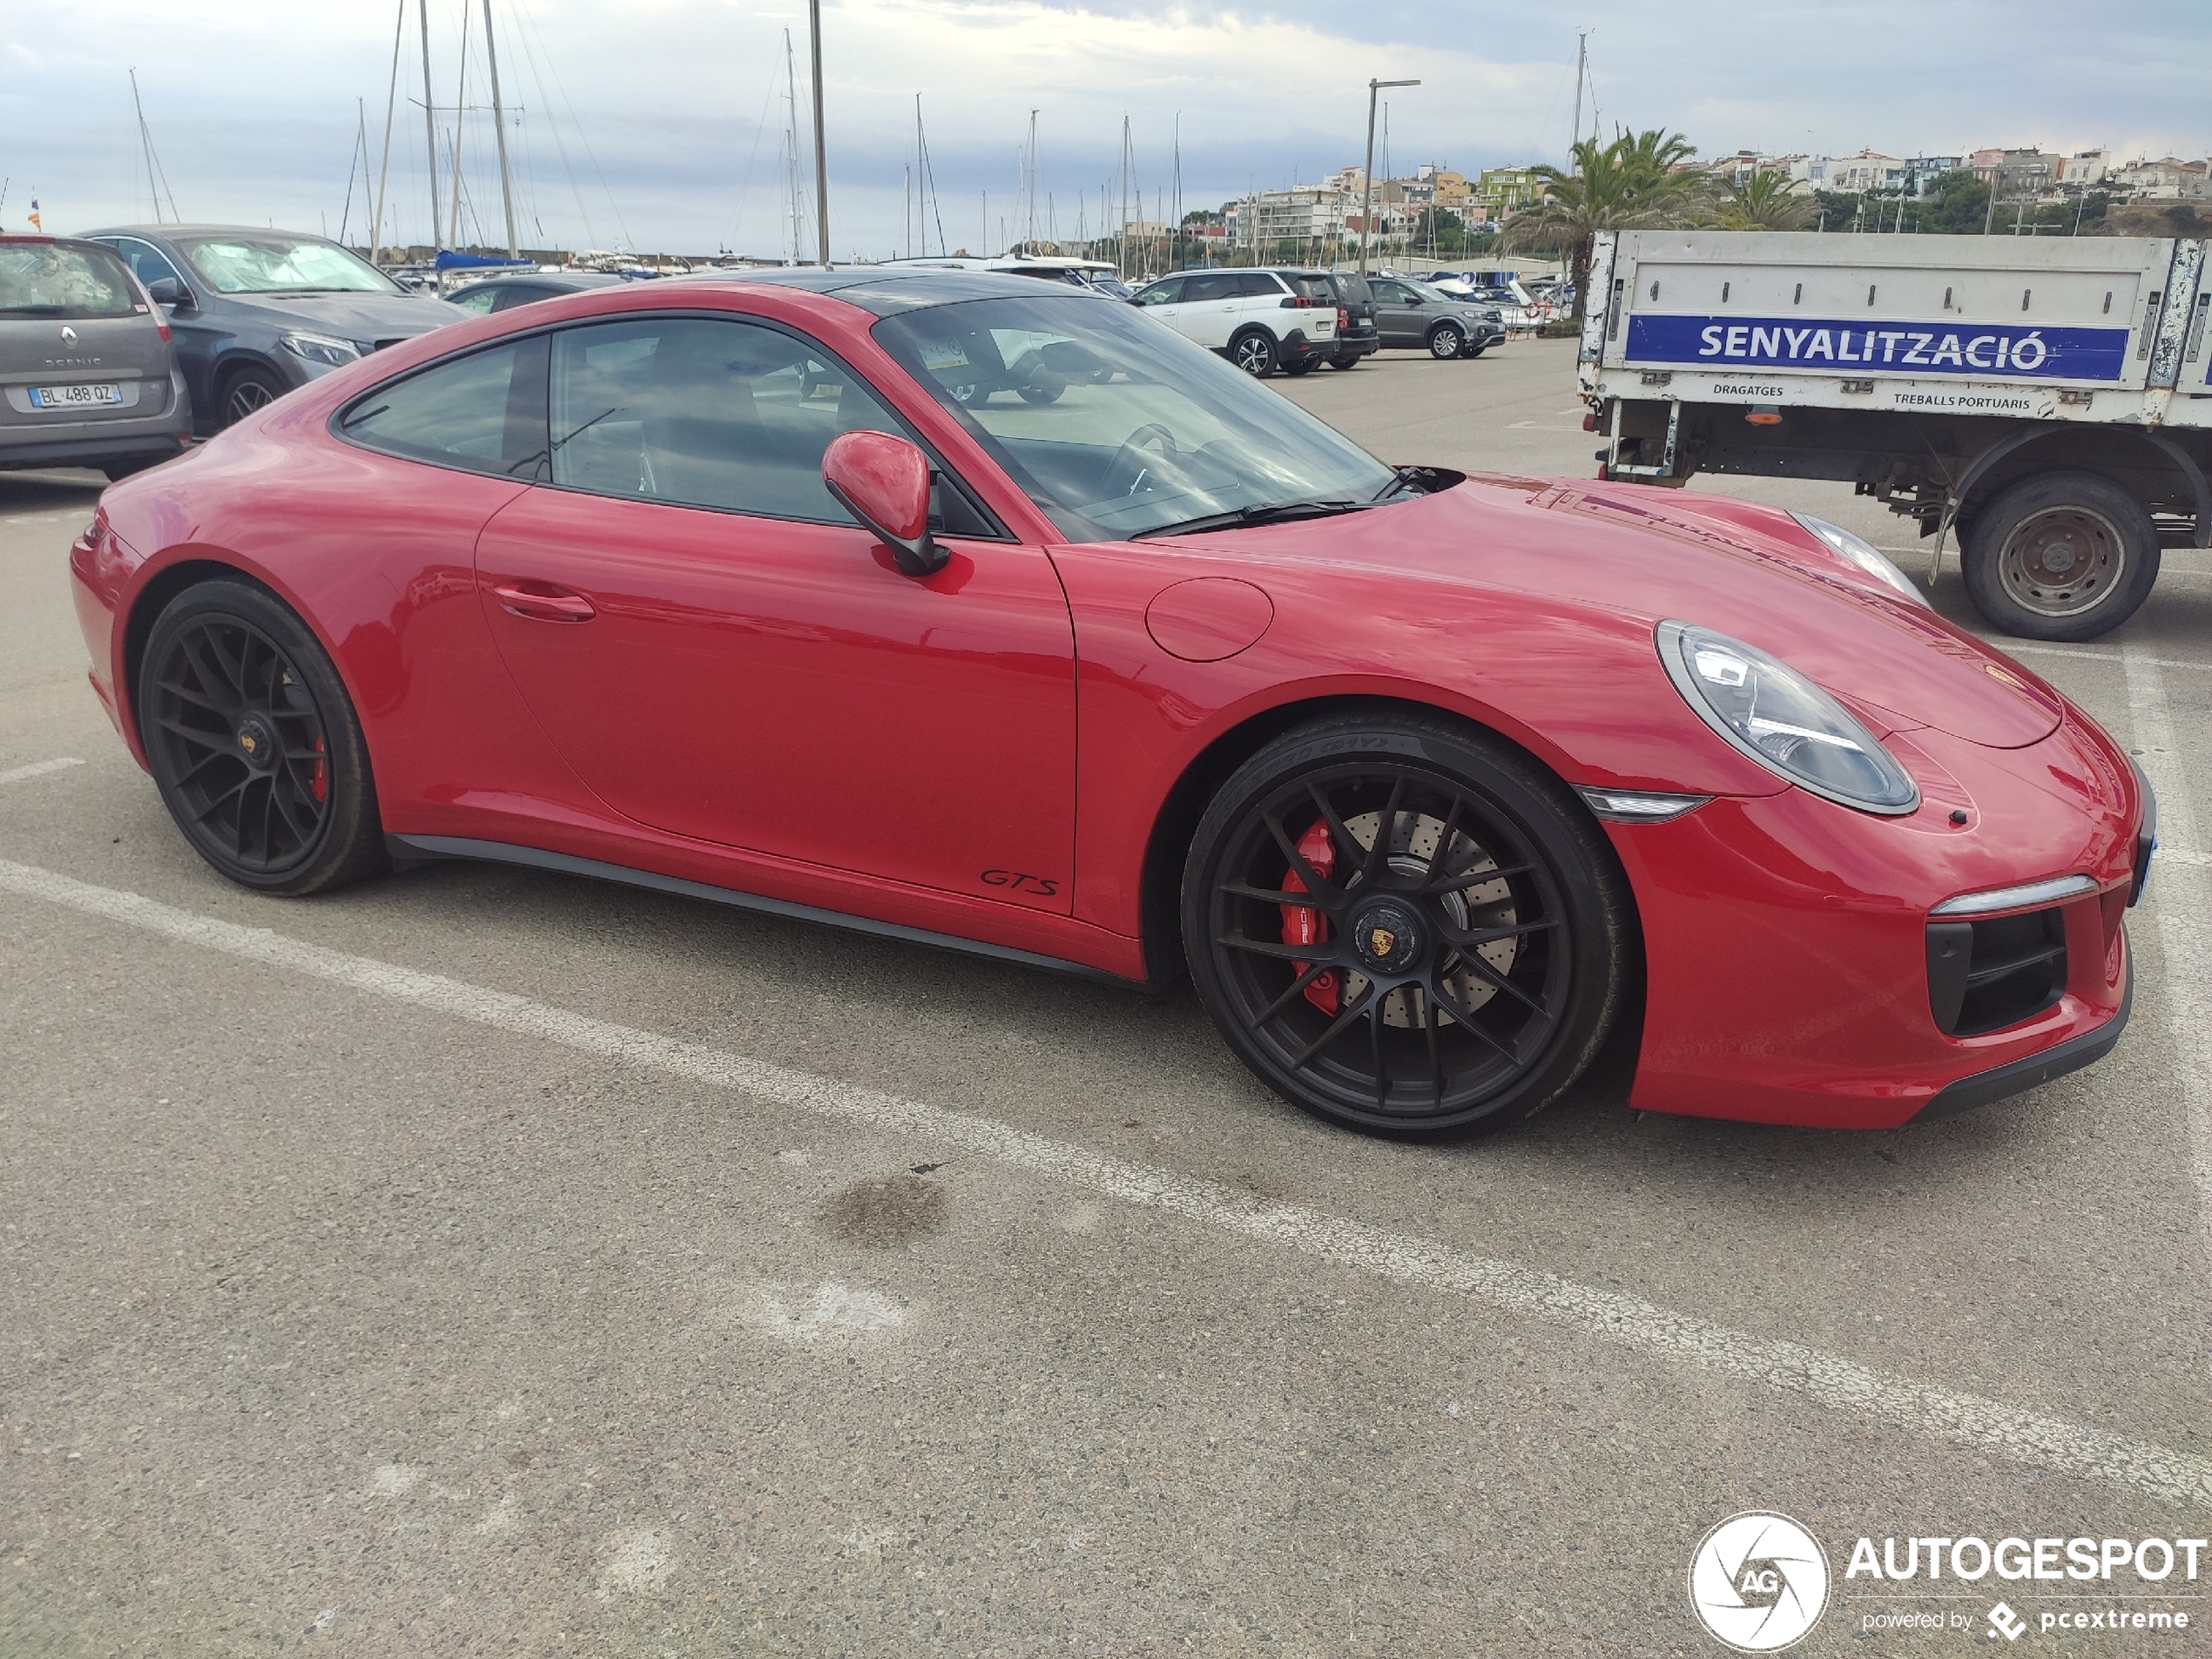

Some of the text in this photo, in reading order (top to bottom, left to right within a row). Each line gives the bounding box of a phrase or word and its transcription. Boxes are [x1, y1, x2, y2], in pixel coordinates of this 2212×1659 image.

[1698, 327, 2047, 370] SENYALITZACIÓ
[1713, 384, 1784, 396] DRAGATGES
[1894, 394, 2030, 410] TREBALLS PORTUARIS
[981, 870, 1059, 896] GTS
